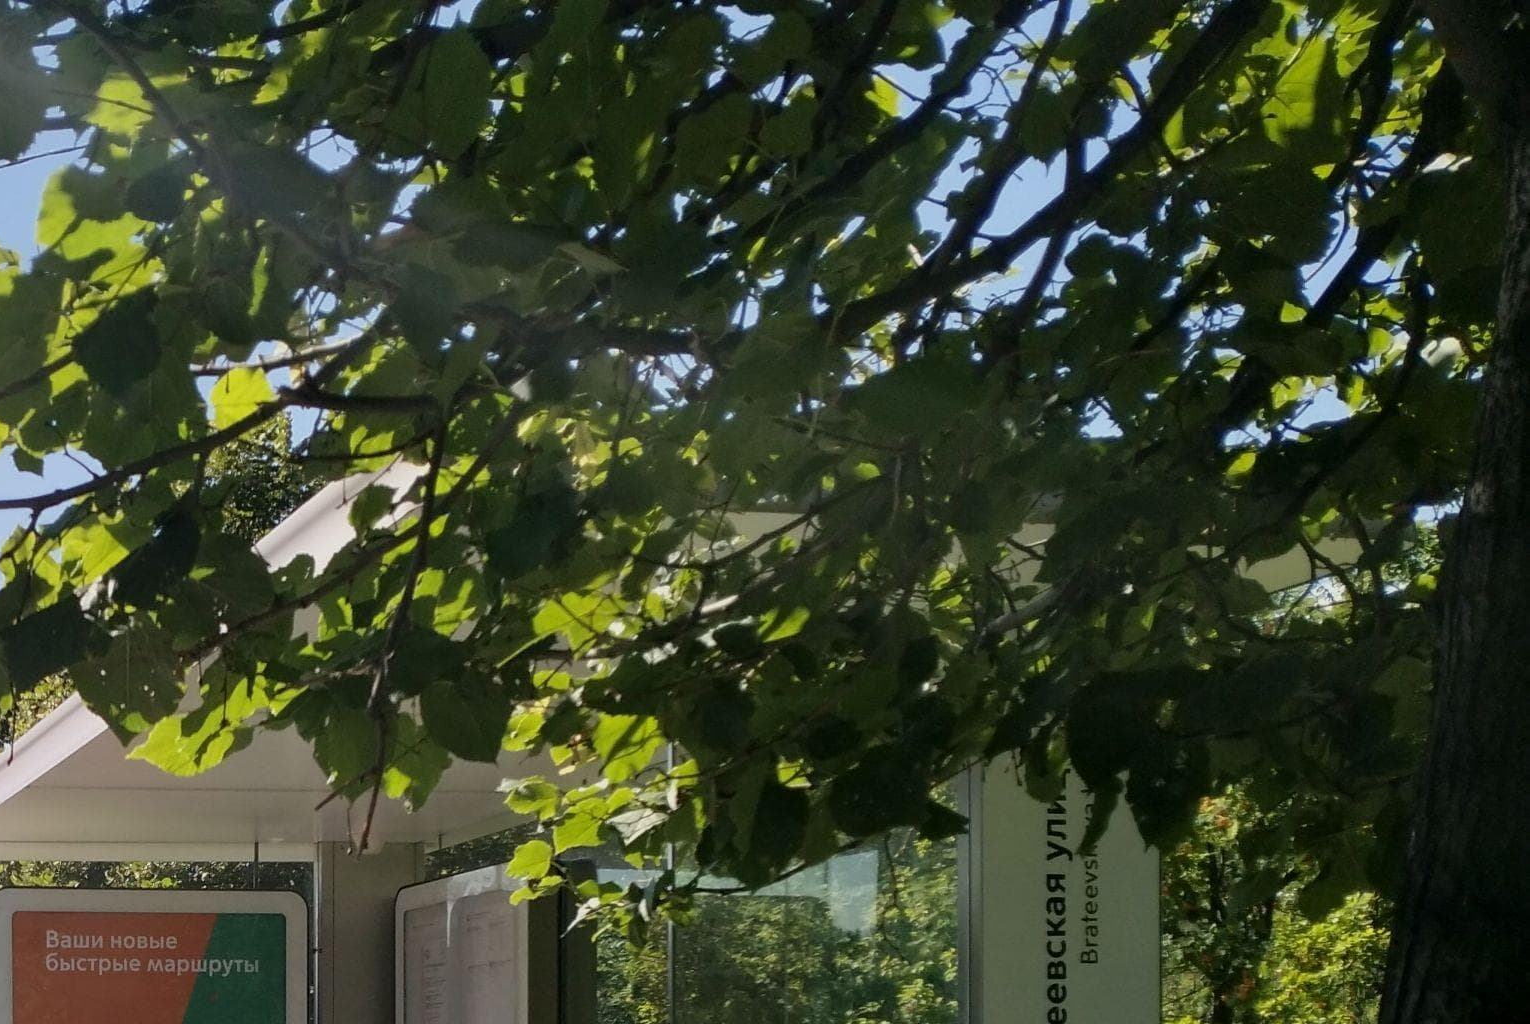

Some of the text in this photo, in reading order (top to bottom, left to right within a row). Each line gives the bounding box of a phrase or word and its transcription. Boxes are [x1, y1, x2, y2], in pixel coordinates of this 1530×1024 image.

[1047, 769, 1074, 862] ули
[46, 929, 178, 950] Ваши новые
[45, 953, 260, 977] быстрые маршруты
